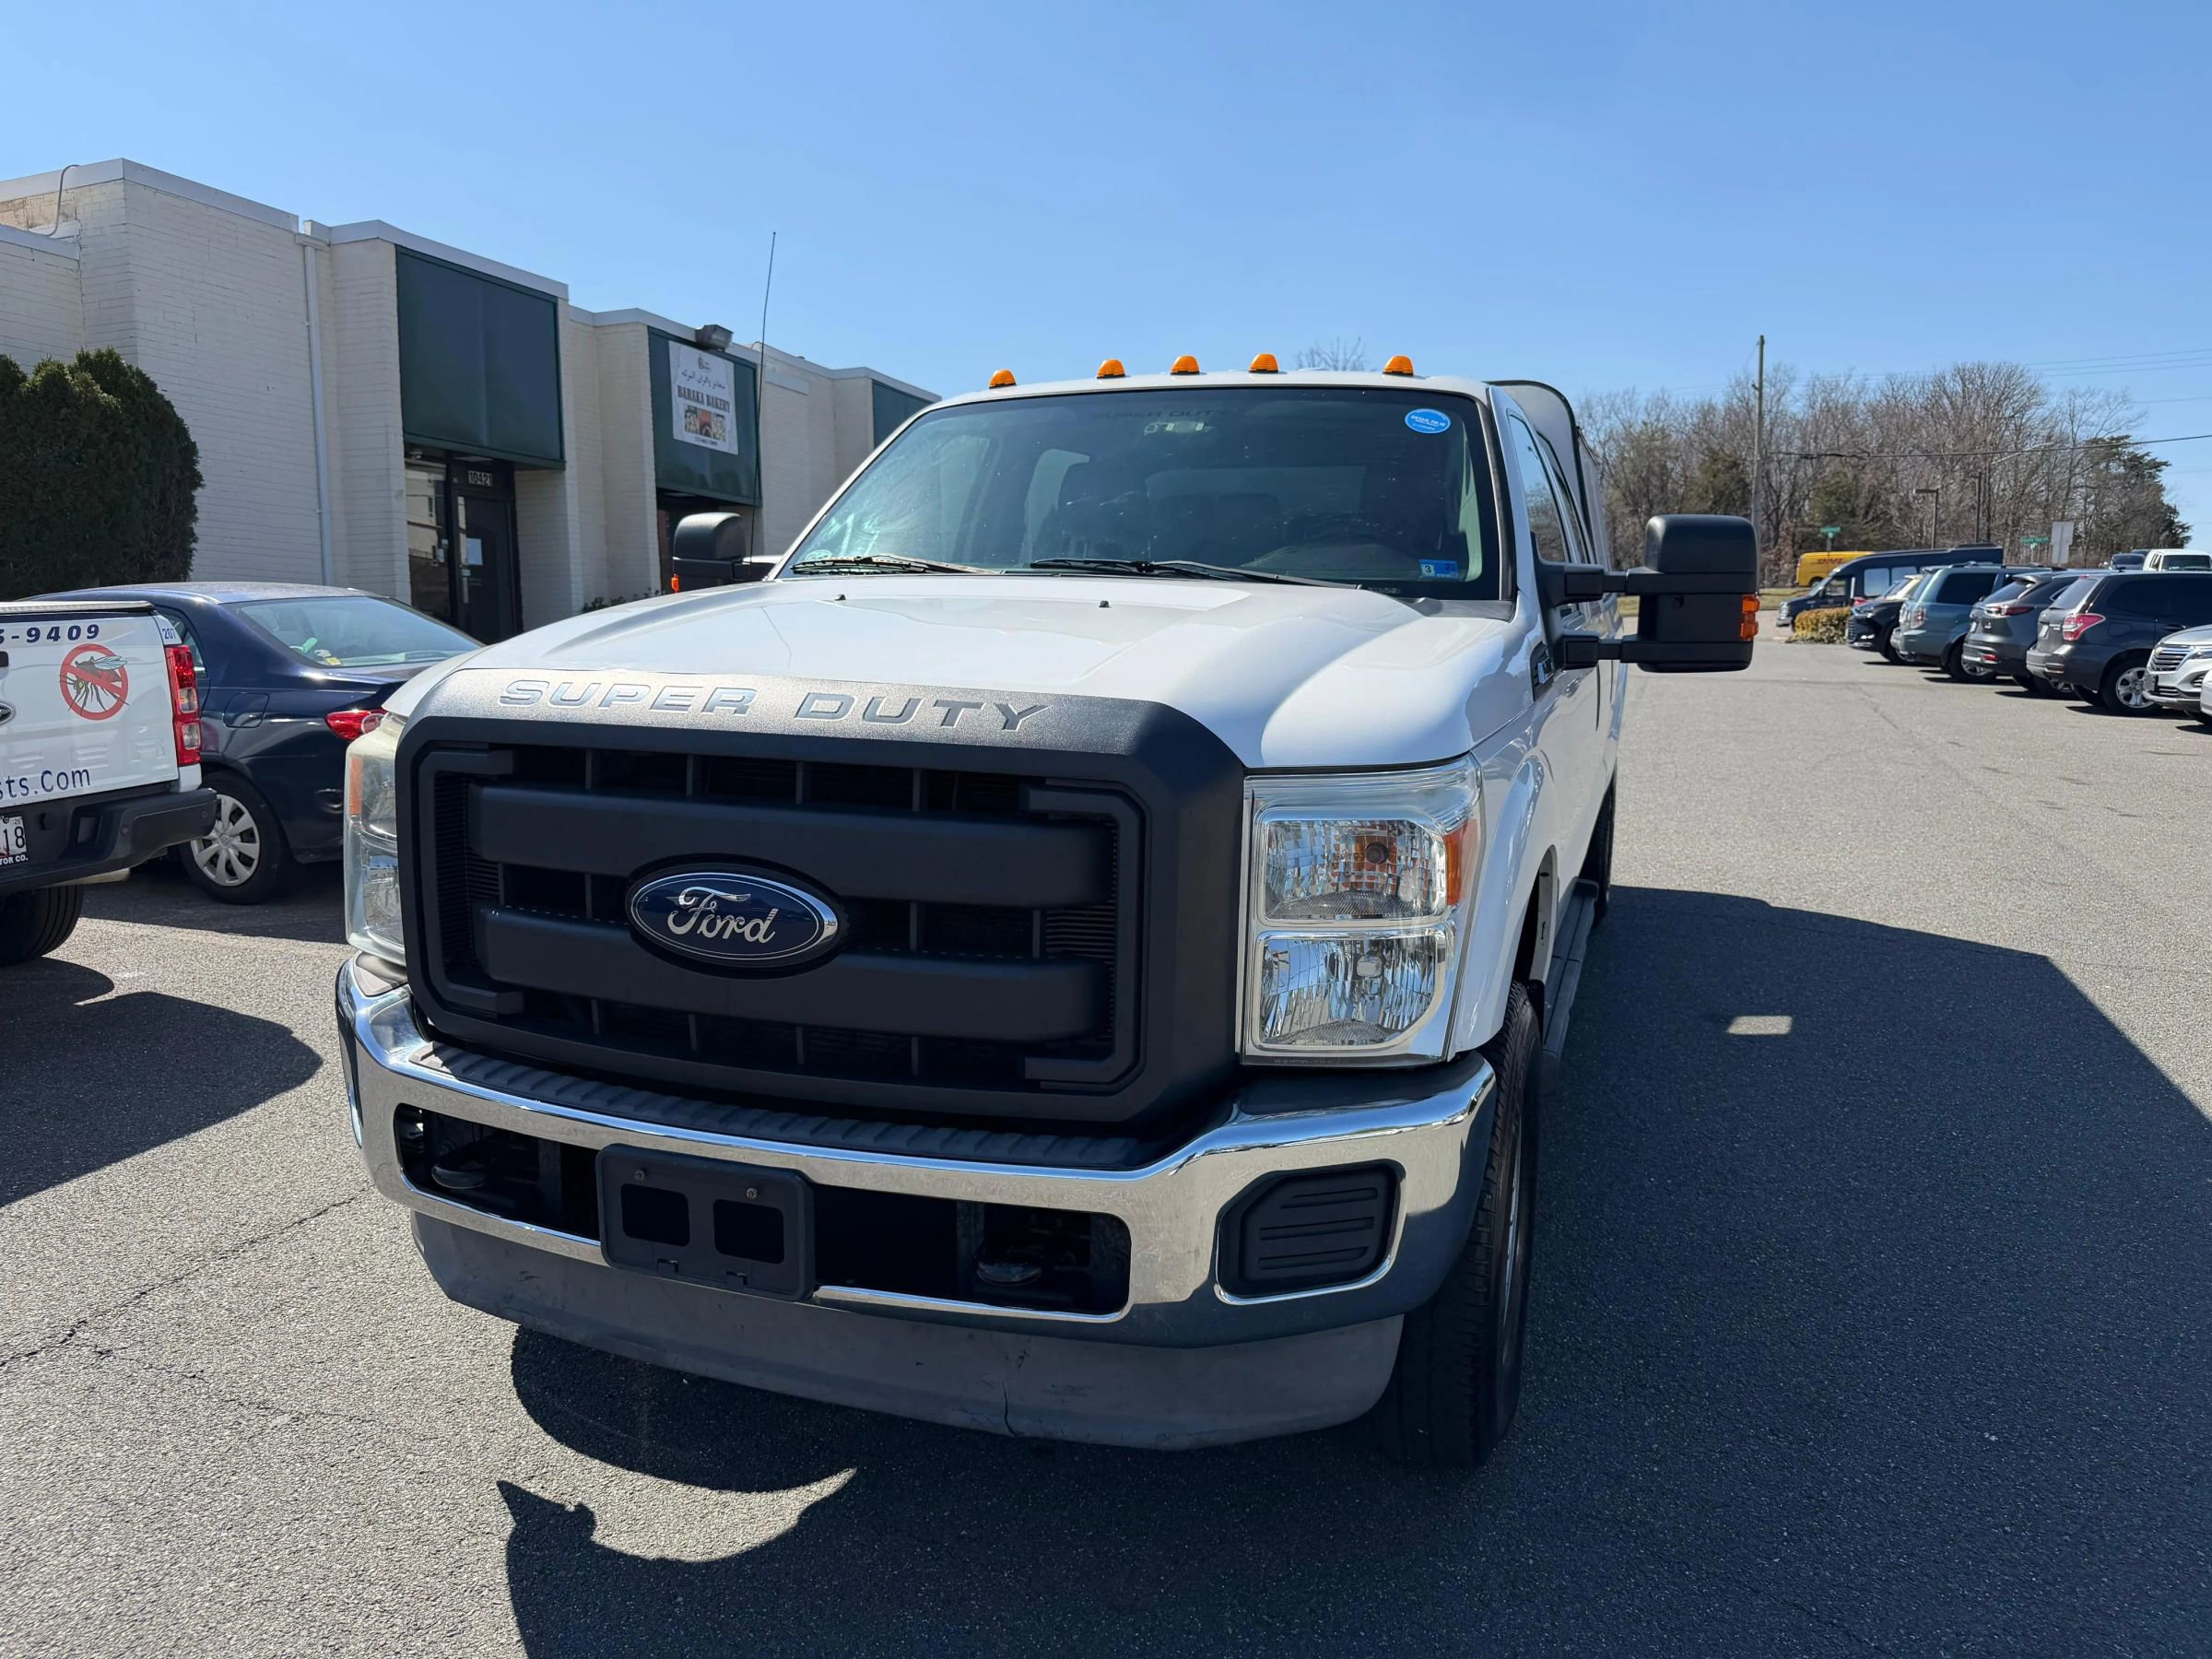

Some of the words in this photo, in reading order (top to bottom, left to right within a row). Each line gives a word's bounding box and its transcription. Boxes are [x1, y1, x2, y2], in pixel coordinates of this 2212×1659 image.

[677, 384, 704, 406] BARAKA
[706, 394, 730, 413] BAKERY
[1424, 565, 1431, 573] 3
[499, 678, 758, 716] SUPER
[794, 691, 1052, 732] DUTY
[15, 854, 29, 863] CO.
[667, 886, 779, 944] Ford
